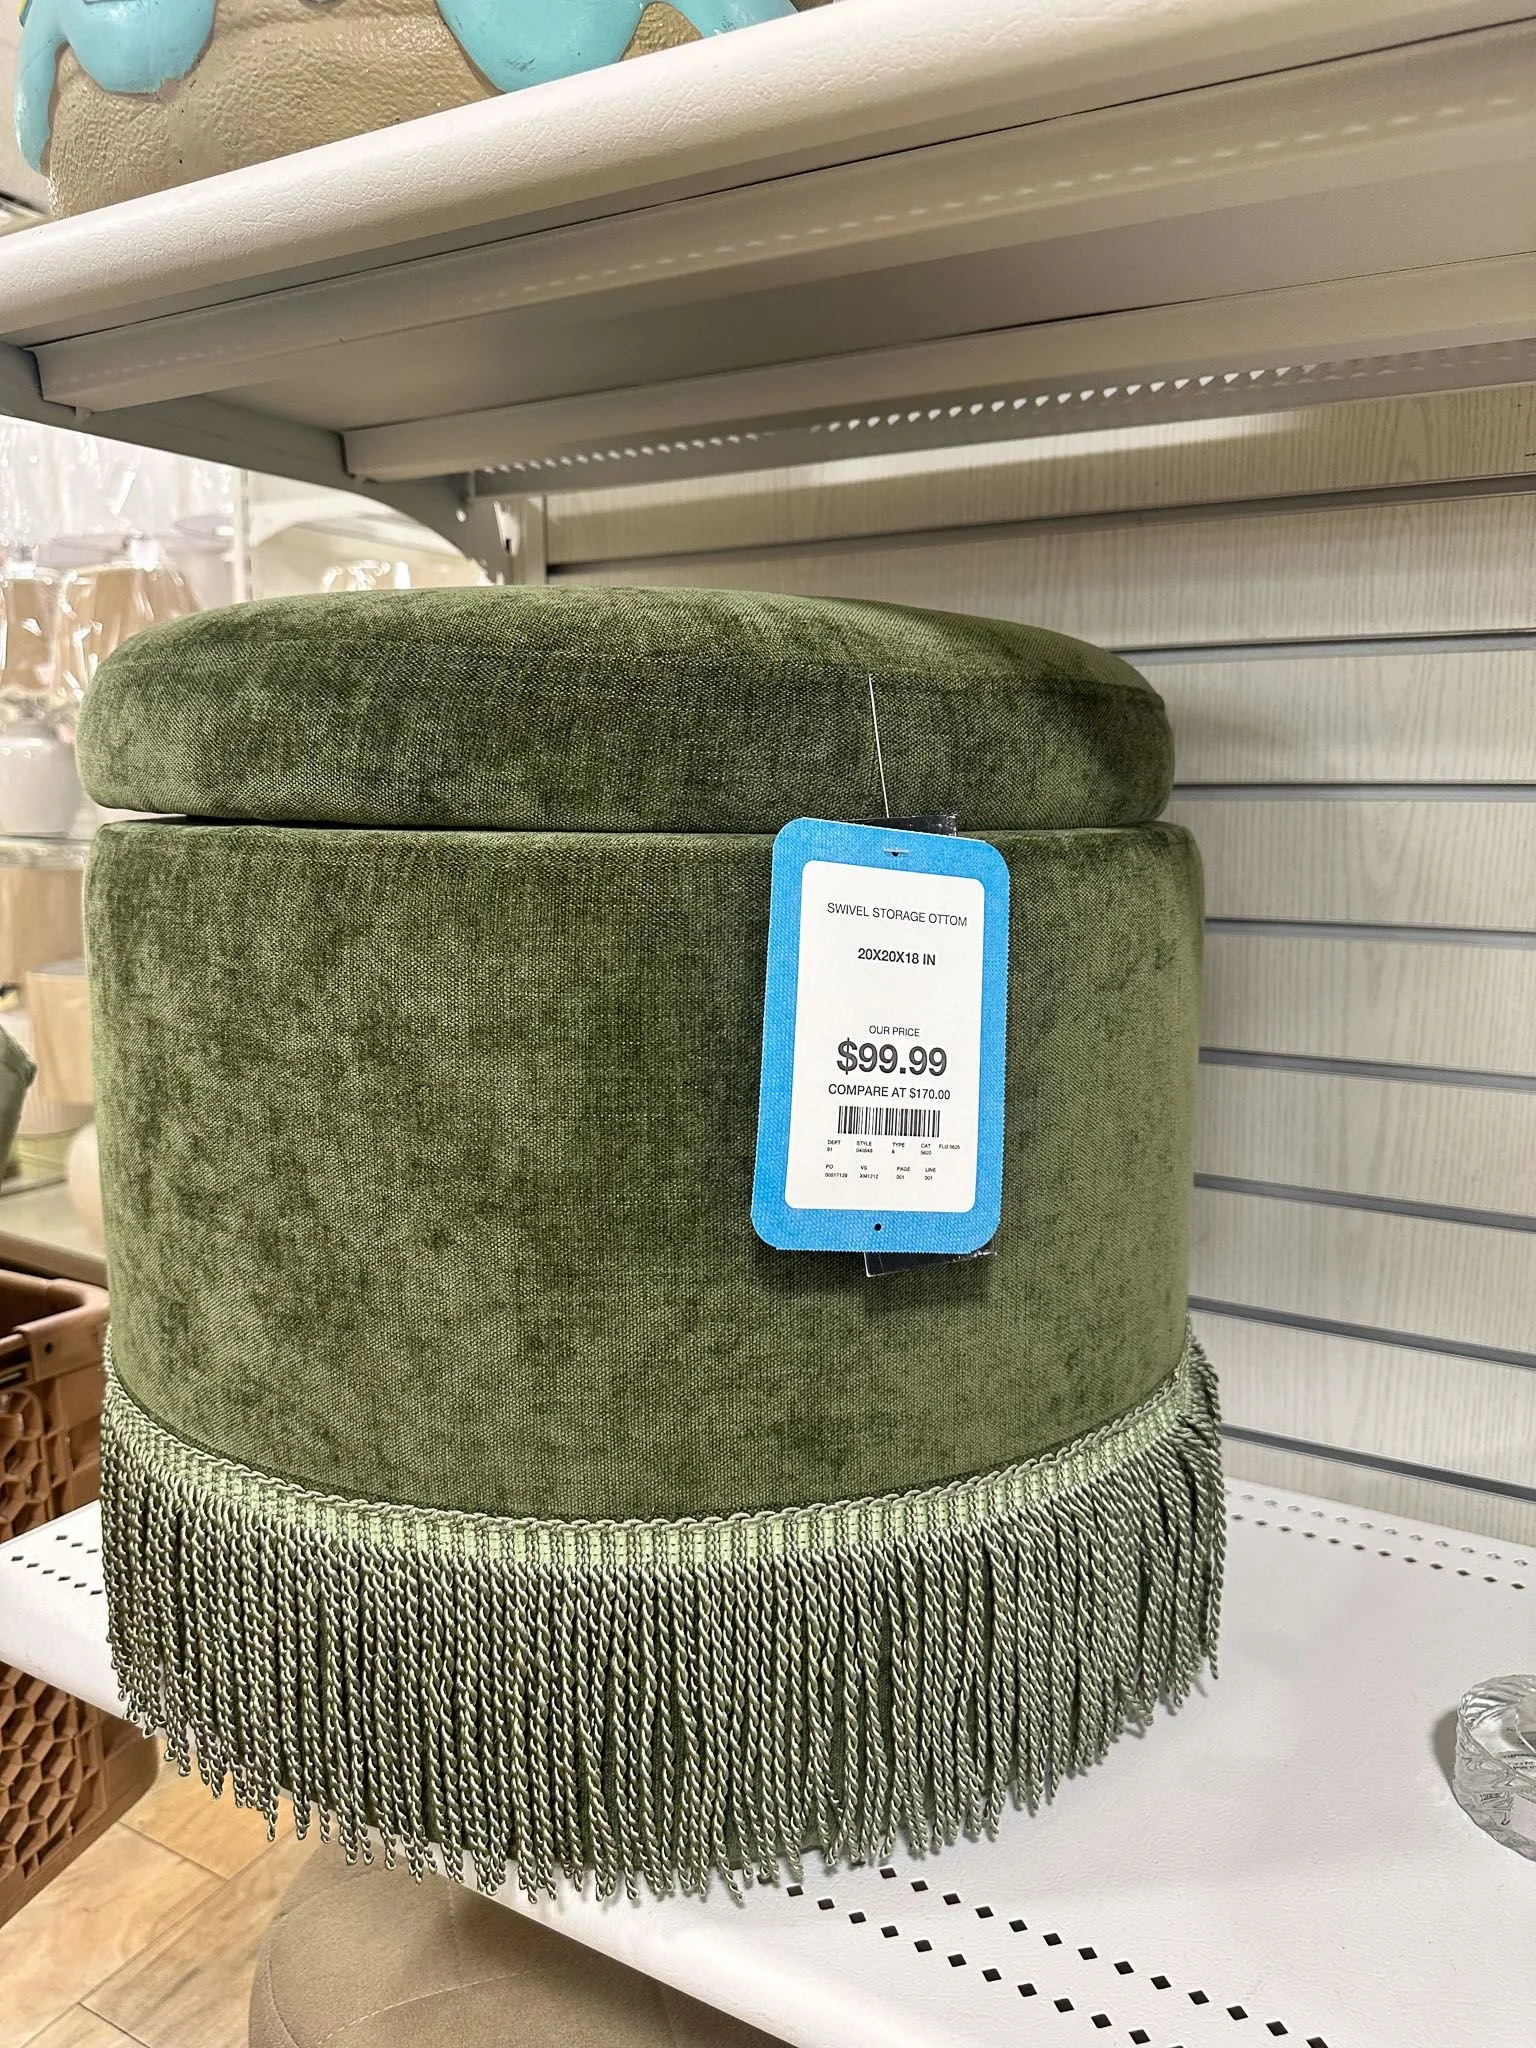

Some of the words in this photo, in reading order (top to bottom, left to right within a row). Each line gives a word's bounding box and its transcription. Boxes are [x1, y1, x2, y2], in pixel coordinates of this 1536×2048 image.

[826, 903, 870, 917] SWIVEL
[872, 907, 926, 922] STORAGE
[928, 913, 968, 926] OTTOM
[857, 948, 920, 964] 20X20X18
[922, 953, 936, 965] IN
[868, 1025, 891, 1035] OUR
[892, 1027, 921, 1038] PRICE
[836, 1037, 948, 1076] $99.99
[827, 1084, 889, 1097] COMPARE
[890, 1087, 908, 1097] AT
[908, 1088, 951, 1100] $170.00
